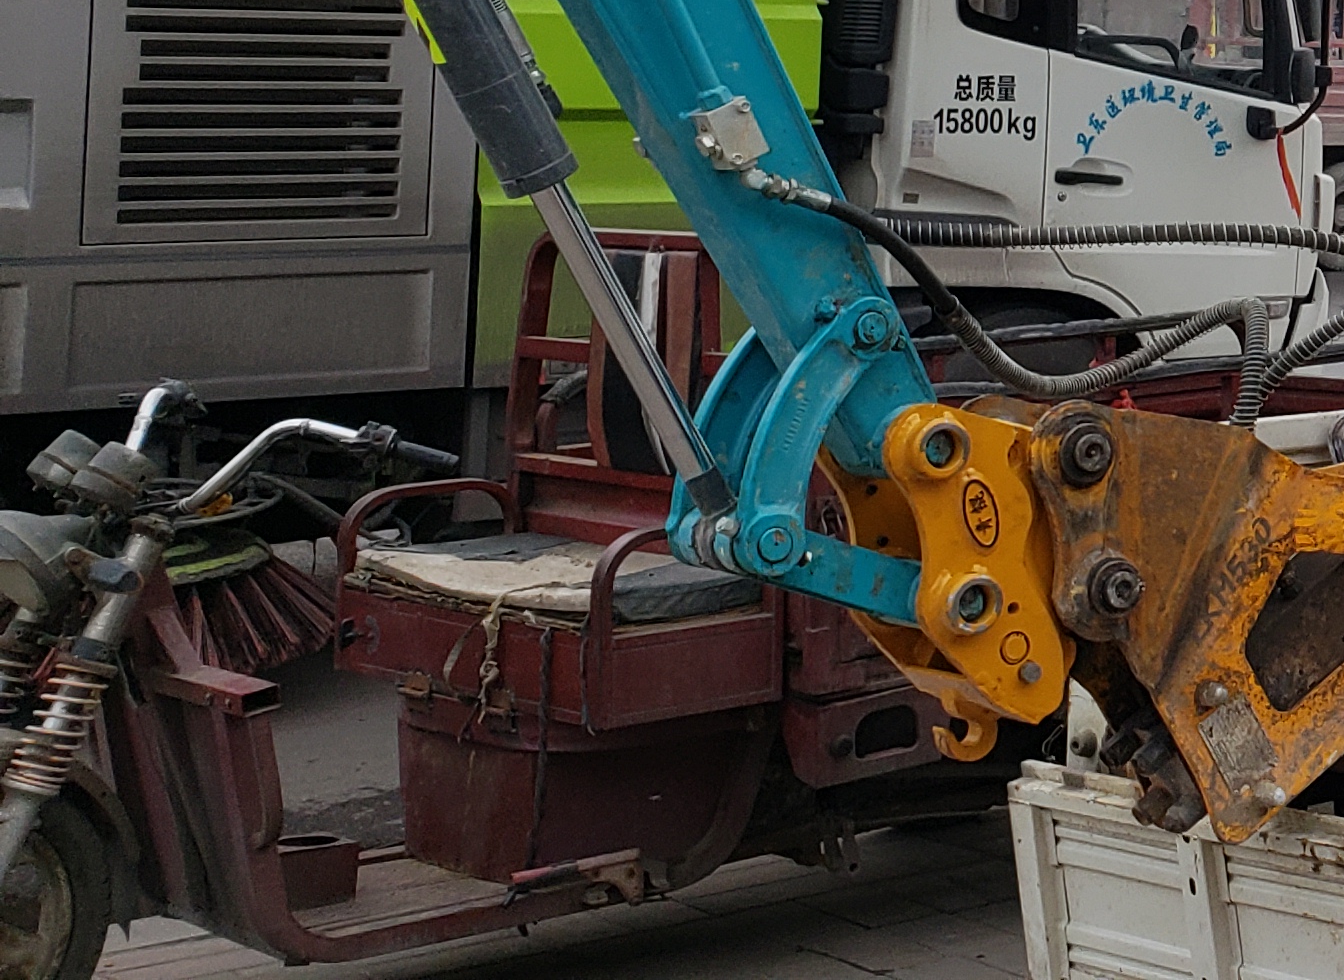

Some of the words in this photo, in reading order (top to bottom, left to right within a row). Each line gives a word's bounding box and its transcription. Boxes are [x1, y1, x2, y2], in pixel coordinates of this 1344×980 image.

[954, 74, 1017, 102] 总质量
[933, 108, 1037, 141] 15800kg
[1076, 80, 1232, 157] 卫东区环境卫生管理局
